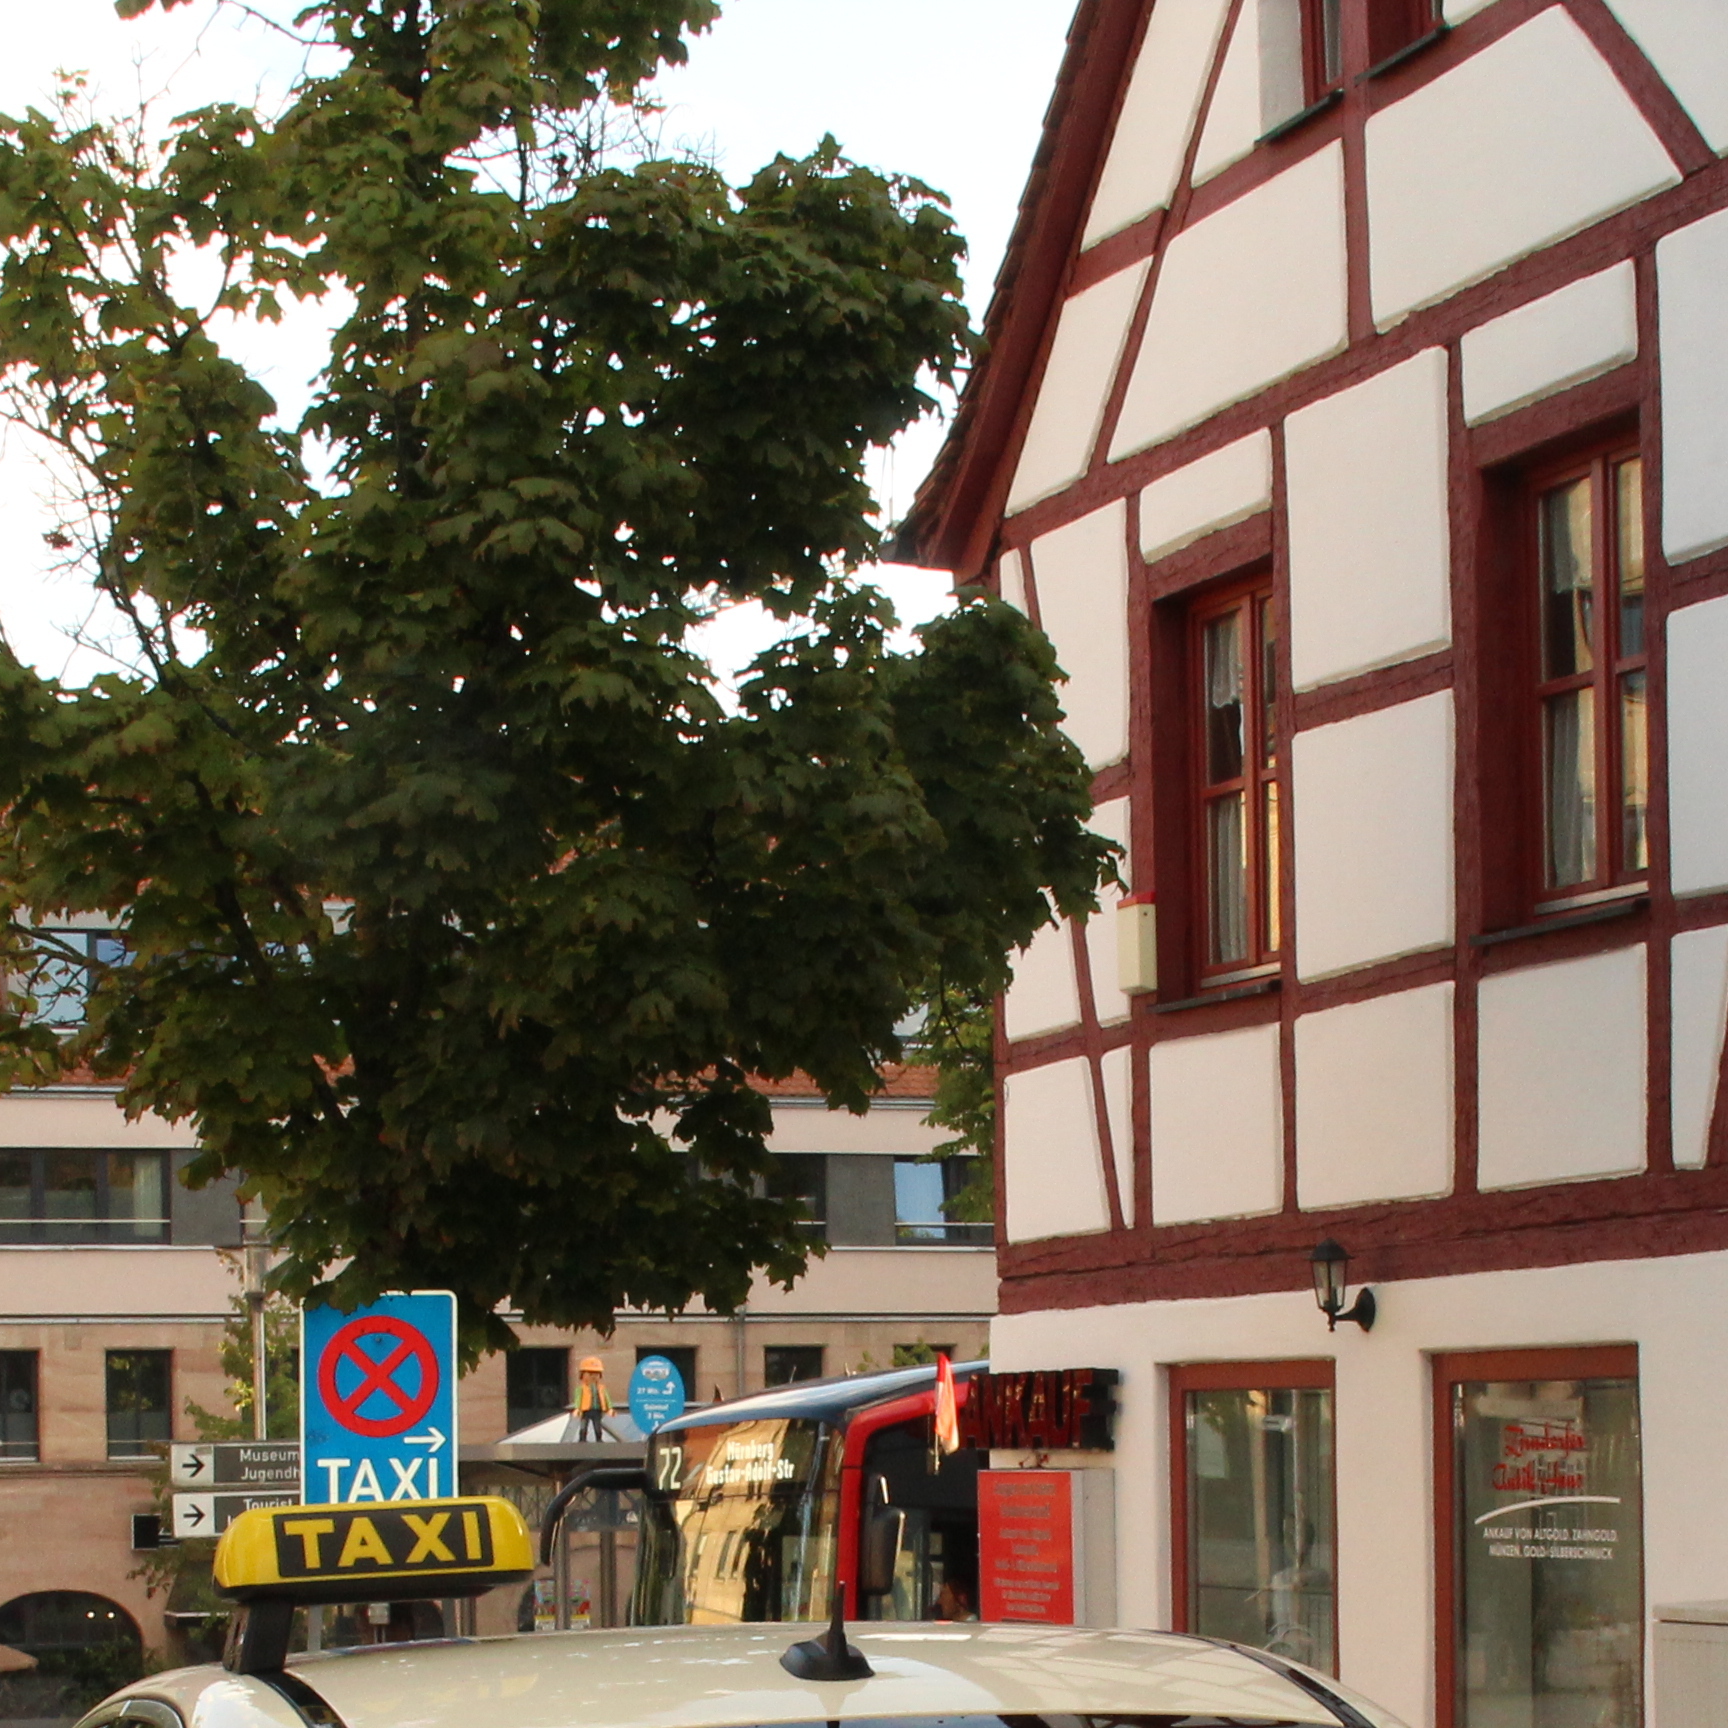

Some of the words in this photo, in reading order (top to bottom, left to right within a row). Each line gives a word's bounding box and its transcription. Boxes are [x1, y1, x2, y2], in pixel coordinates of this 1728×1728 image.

[959, 1370, 1094, 1450] ANKAUF
[239, 1449, 299, 1463] Museum
[658, 1446, 682, 1490] 72
[727, 1440, 775, 1461] Nürnberg
[317, 1458, 439, 1504] TAXI
[705, 1459, 795, 1485] Gustav-Adolf-Str
[283, 1511, 483, 1569] TAXI
[1483, 1527, 1513, 1540] ANKAUF
[1514, 1527, 1532, 1540] VON
